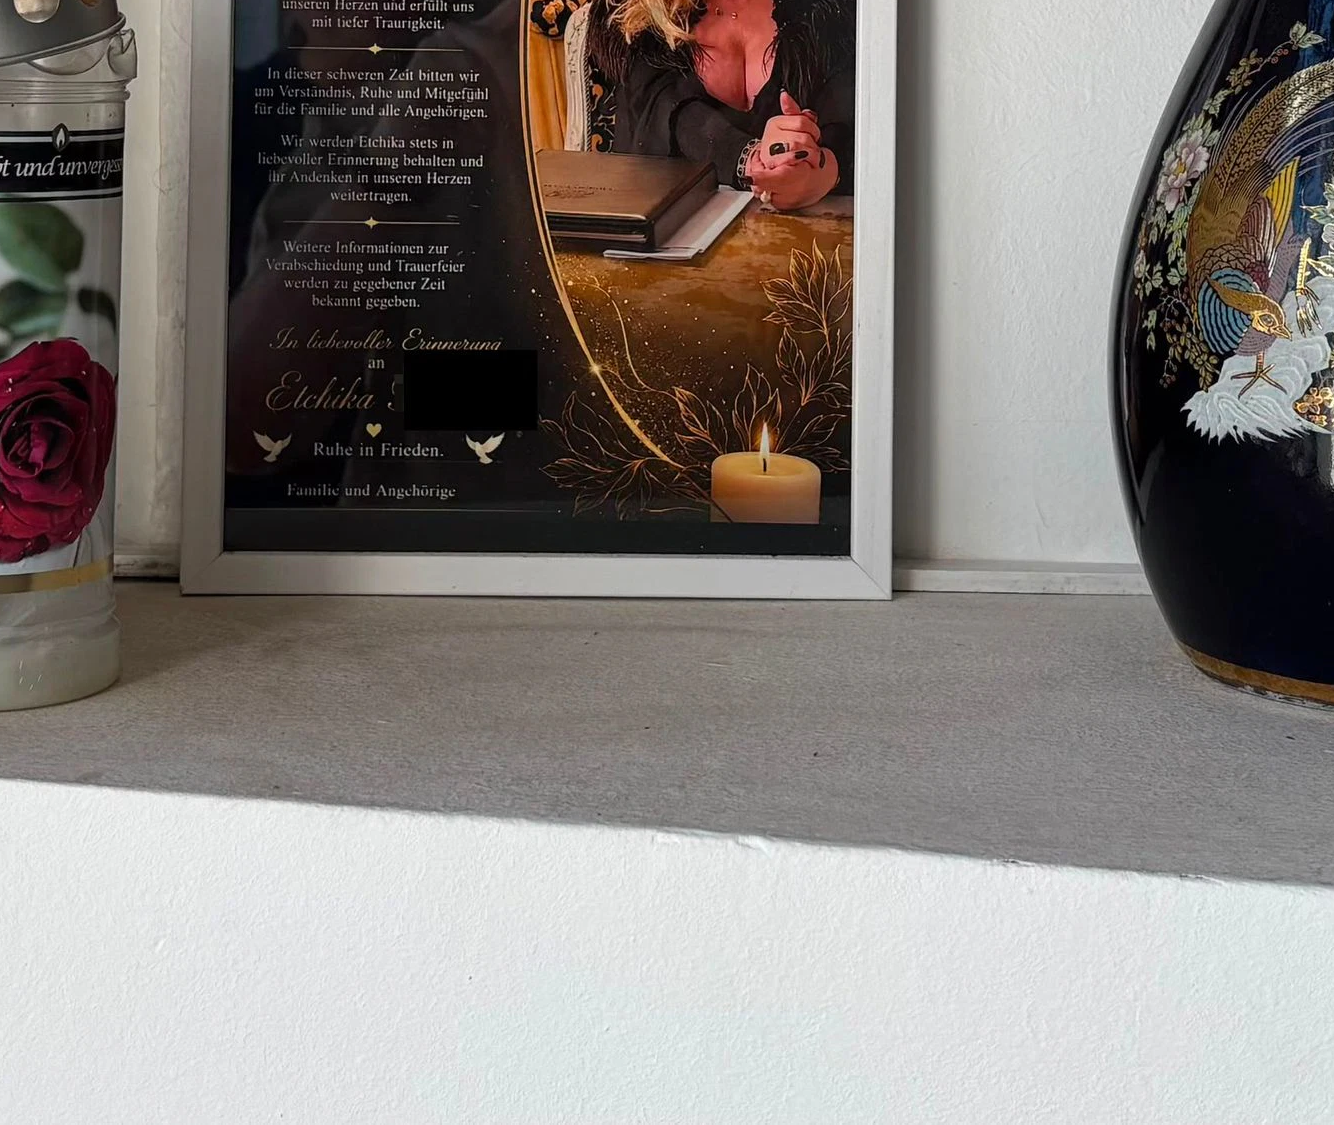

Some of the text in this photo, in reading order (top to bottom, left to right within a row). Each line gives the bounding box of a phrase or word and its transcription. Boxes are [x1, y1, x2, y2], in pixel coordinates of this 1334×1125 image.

[282, 0, 329, 10] unseren
[383, 0, 406, 11] und
[410, 0, 447, 11] erfüllt
[453, 2, 474, 12] uns
[312, 16, 444, 32] mit tiefer Traurigkeit.
[268, 68, 479, 82] In dieser schweren Zeit bitten wir
[255, 85, 488, 102] um Verständnis, Ruhe und Mitgefühl
[255, 103, 488, 120] für die Familie und alle Angehörigen.
[281, 135, 454, 148] Wir werden Etchika stets in
[14, 156, 61, 176] und
[258, 153, 483, 168] liebevoller Erinnerung behalten und
[290, 171, 352, 183] Andenken
[358, 171, 368, 183] in
[374, 175, 422, 184] unseren
[427, 172, 471, 184] Herzen
[331, 190, 411, 204] weitertragen.
[283, 241, 449, 254] Weitere Informationen zur
[266, 259, 465, 274] Verabschiedung und Trauerfeier
[284, 277, 445, 292] werden zu gegebener Zeit
[312, 295, 420, 310] bekannt gegeben.
[269, 327, 299, 349] In
[307, 329, 394, 350] liebevoller
[368, 358, 384, 369] an
[266, 371, 375, 411] Etchika
[314, 442, 443, 457] Ruhe in Frieden.
[288, 484, 456, 499] Familie und Angehörige
